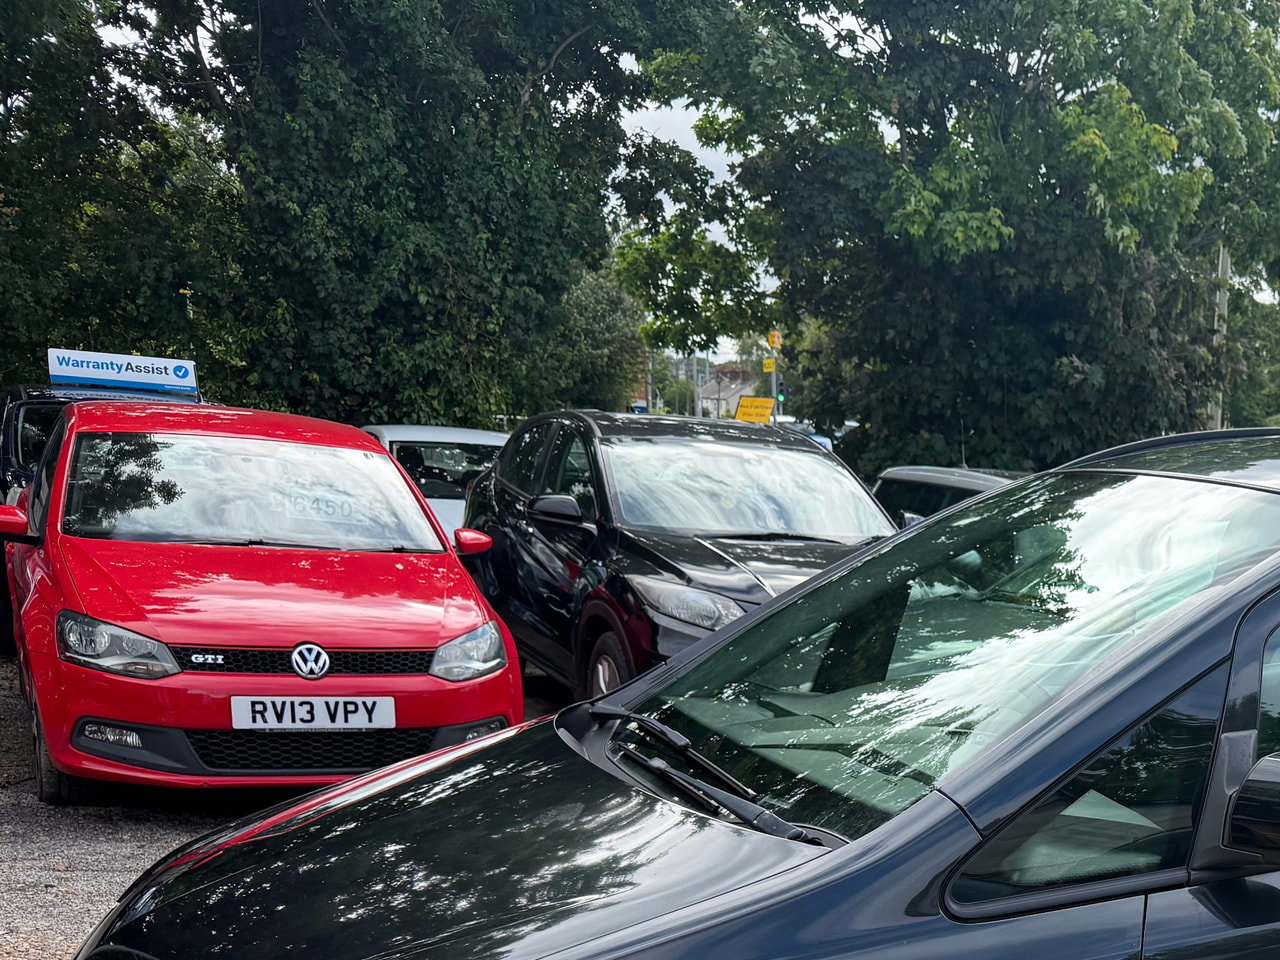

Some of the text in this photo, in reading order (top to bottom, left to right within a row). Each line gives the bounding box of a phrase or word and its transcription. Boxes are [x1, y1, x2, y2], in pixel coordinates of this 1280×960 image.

[191, 654, 224, 664] GTI
[250, 700, 377, 724] RV13 VPY
